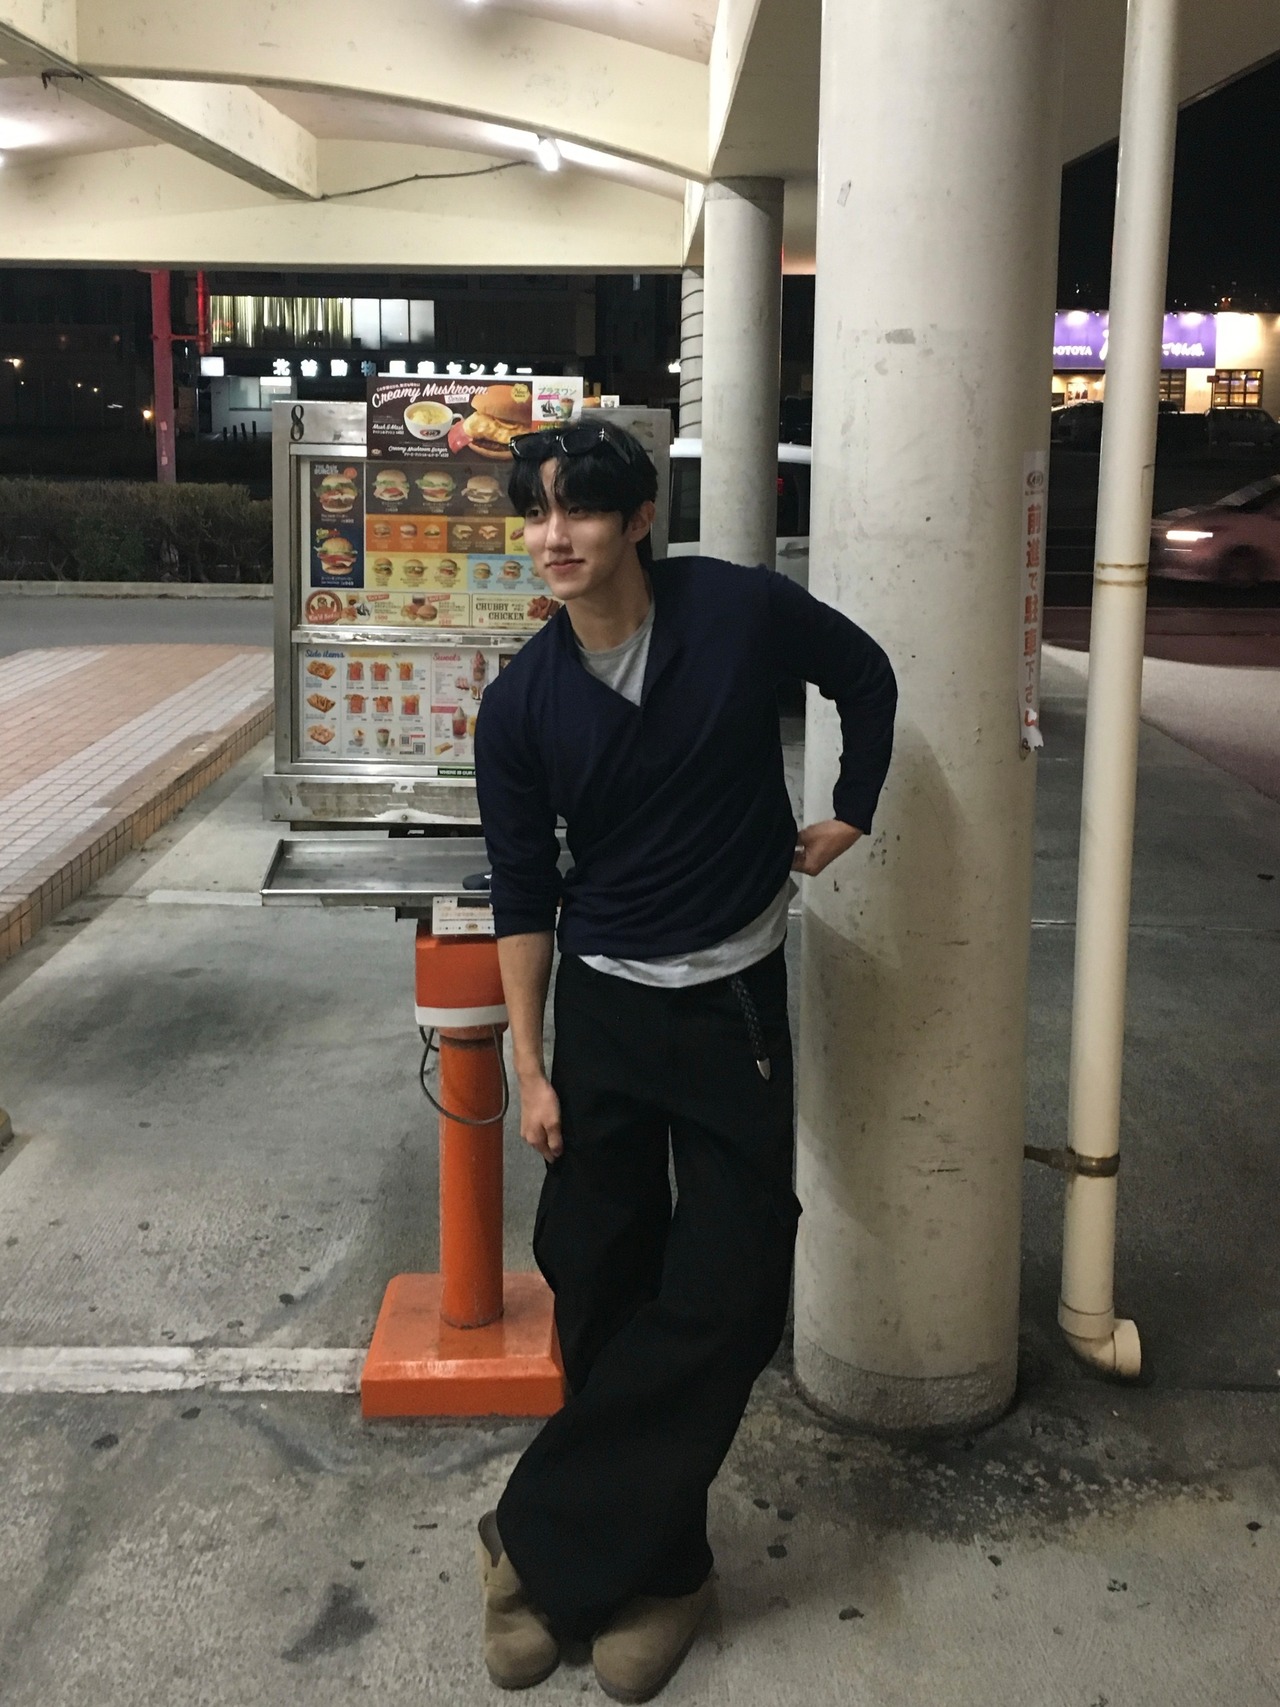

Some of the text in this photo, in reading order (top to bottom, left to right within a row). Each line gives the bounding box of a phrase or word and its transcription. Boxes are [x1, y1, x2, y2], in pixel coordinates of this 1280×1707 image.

[372, 386, 421, 408] Creamy
[422, 381, 489, 398] Mushroom
[290, 404, 304, 441] 8
[476, 602, 509, 611] CHUBBY
[488, 612, 524, 620] CHICKEN
[305, 649, 345, 658] Side items
[433, 652, 461, 661] Sweets
